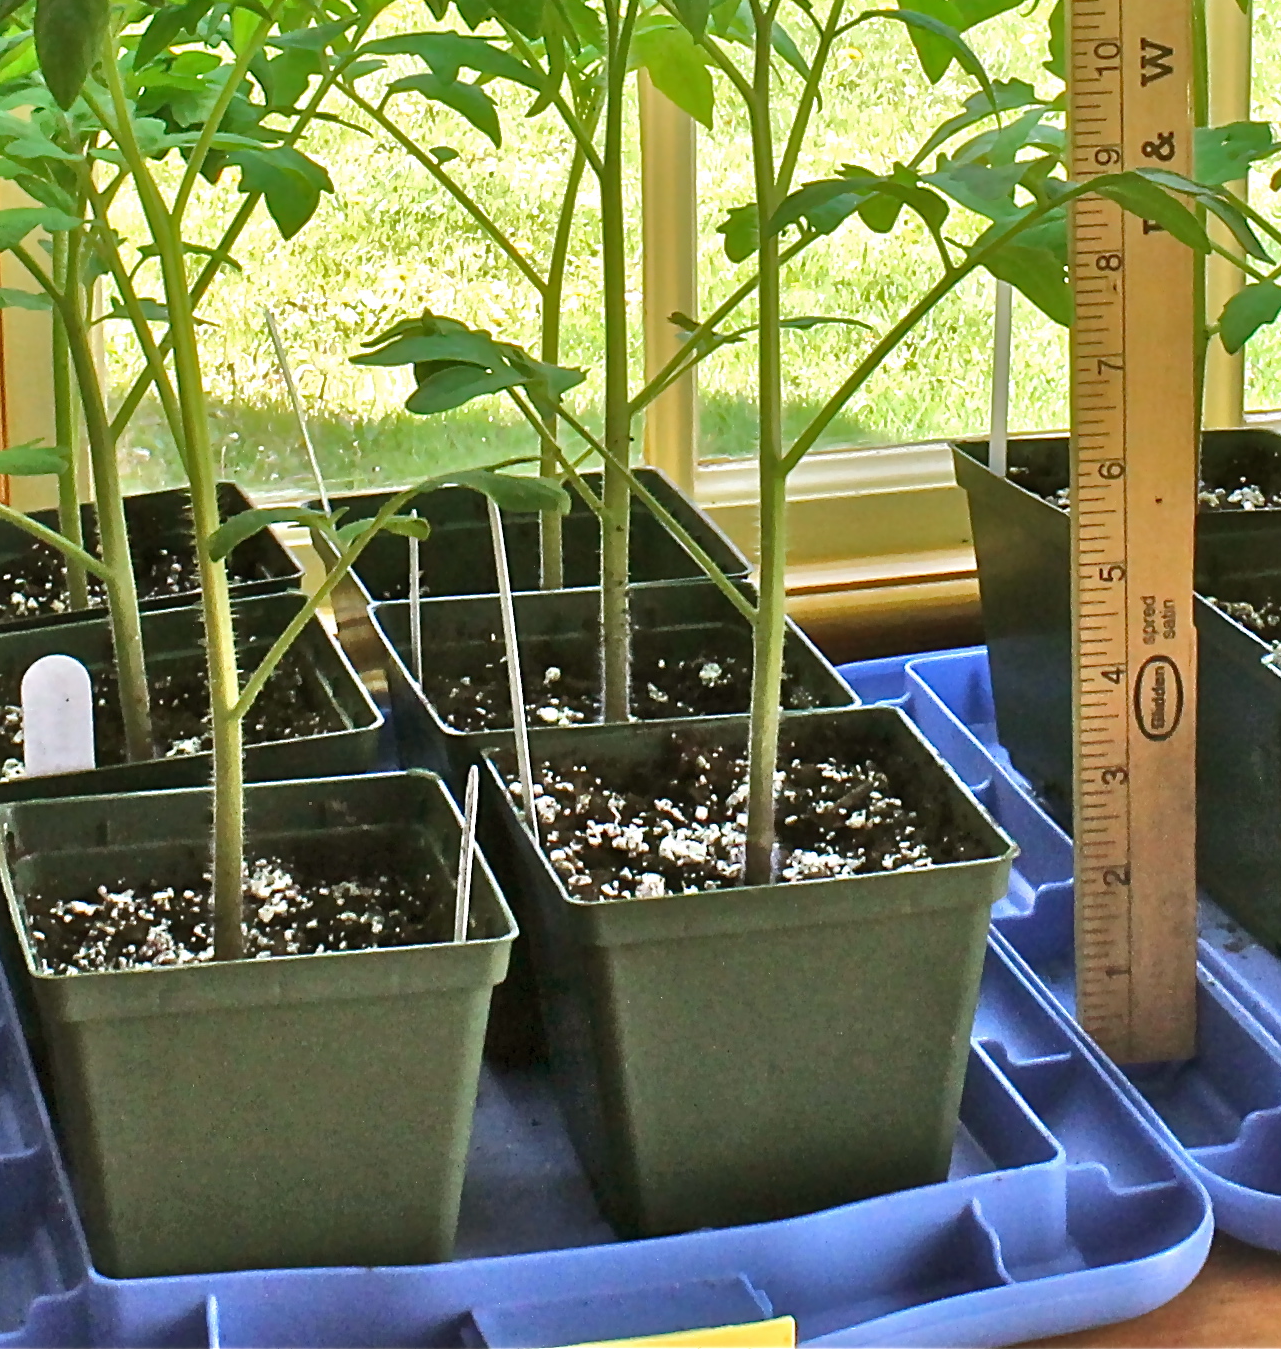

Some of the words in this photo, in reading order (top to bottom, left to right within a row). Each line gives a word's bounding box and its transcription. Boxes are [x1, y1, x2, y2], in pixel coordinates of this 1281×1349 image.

[1094, 41, 1120, 78] 10
[1139, 36, 1174, 88] W
[1140, 130, 1176, 163] &
[1095, 147, 1121, 166] 9
[1096, 253, 1123, 272] 8
[1097, 358, 1126, 376] 7
[1098, 461, 1125, 481] 6
[1099, 564, 1126, 583] 5
[1100, 665, 1127, 686] 4
[1101, 767, 1129, 786] 3
[1103, 861, 1132, 886] 2
[1105, 964, 1132, 979] 1
